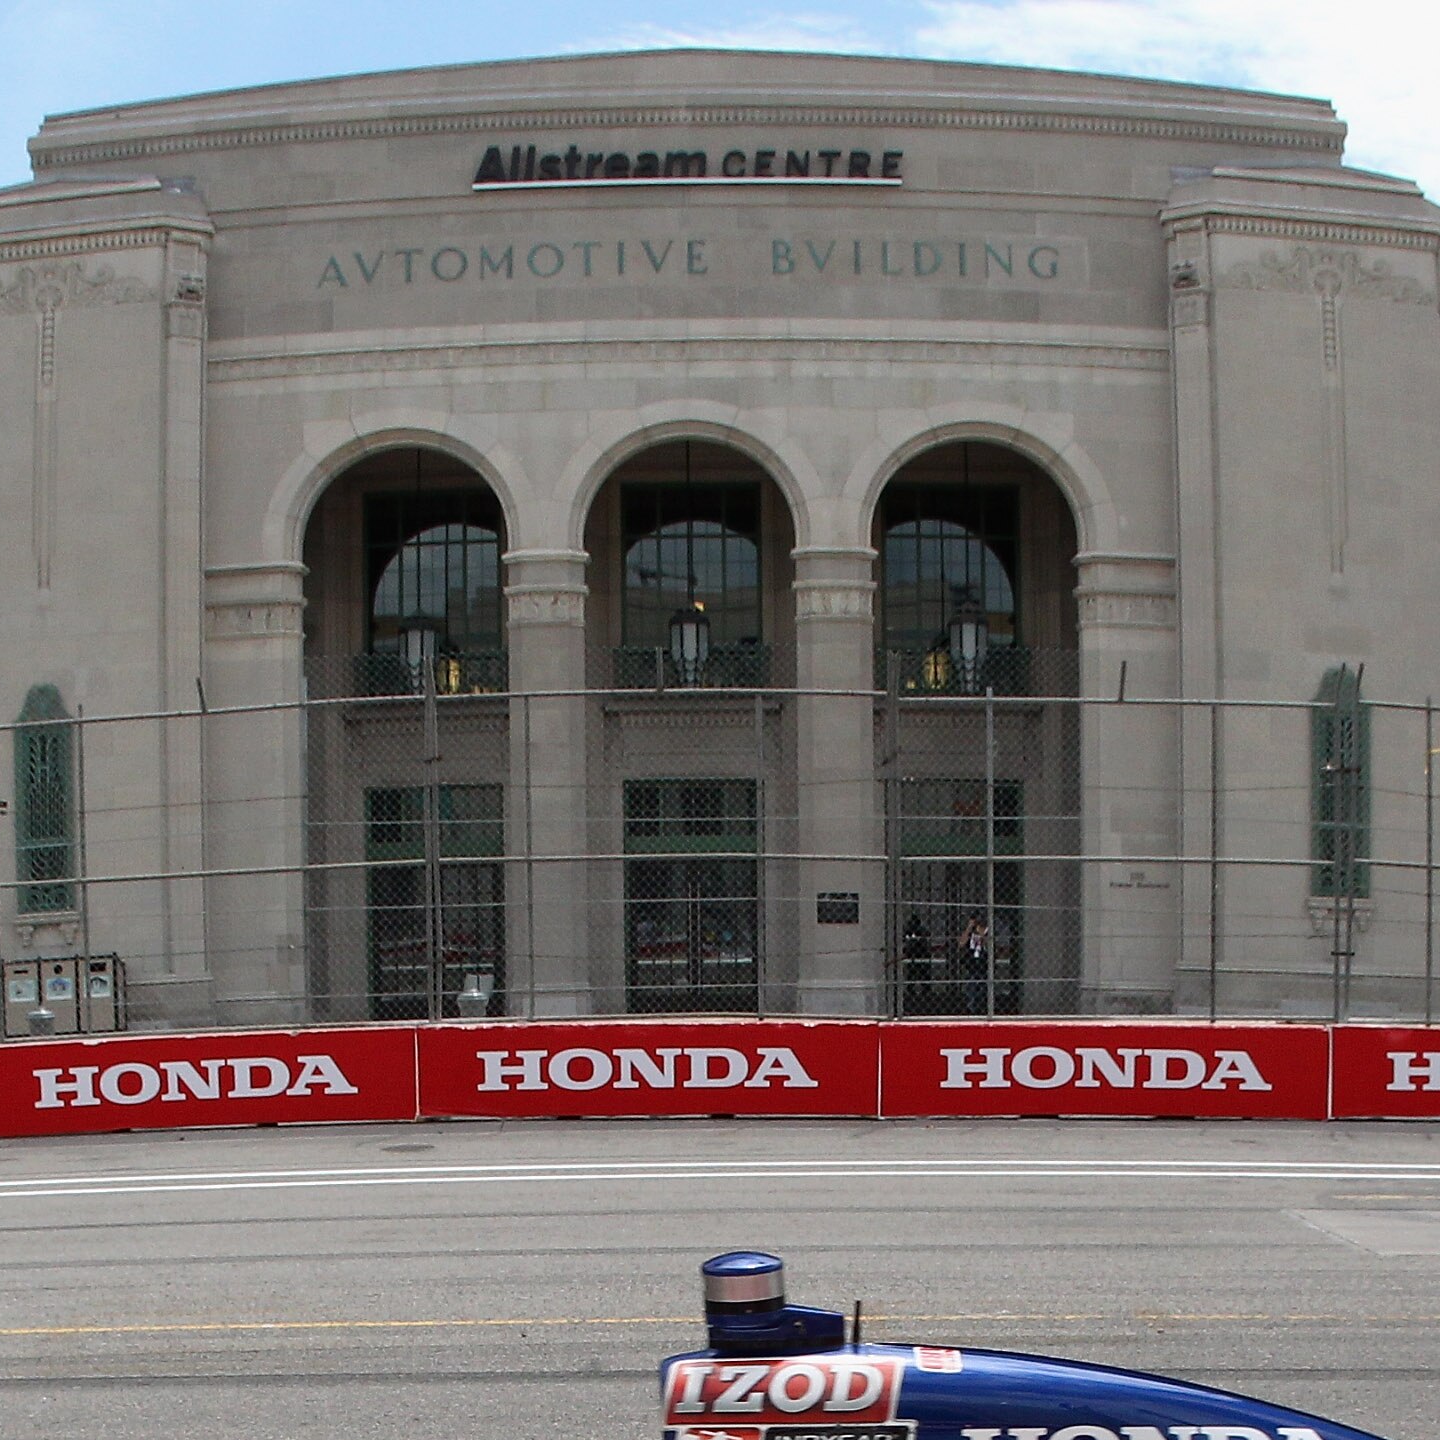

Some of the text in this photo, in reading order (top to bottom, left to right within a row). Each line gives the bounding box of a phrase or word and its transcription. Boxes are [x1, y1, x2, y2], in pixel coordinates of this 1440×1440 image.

[474, 144, 904, 181] Allstream CENTRE
[317, 239, 1061, 288] AVTOMOTIVE BVILDING
[32, 1055, 359, 1109] HONDA
[475, 1047, 819, 1093] HONDA
[939, 1046, 1273, 1093] HONDA
[674, 1363, 885, 1414] IZOD
